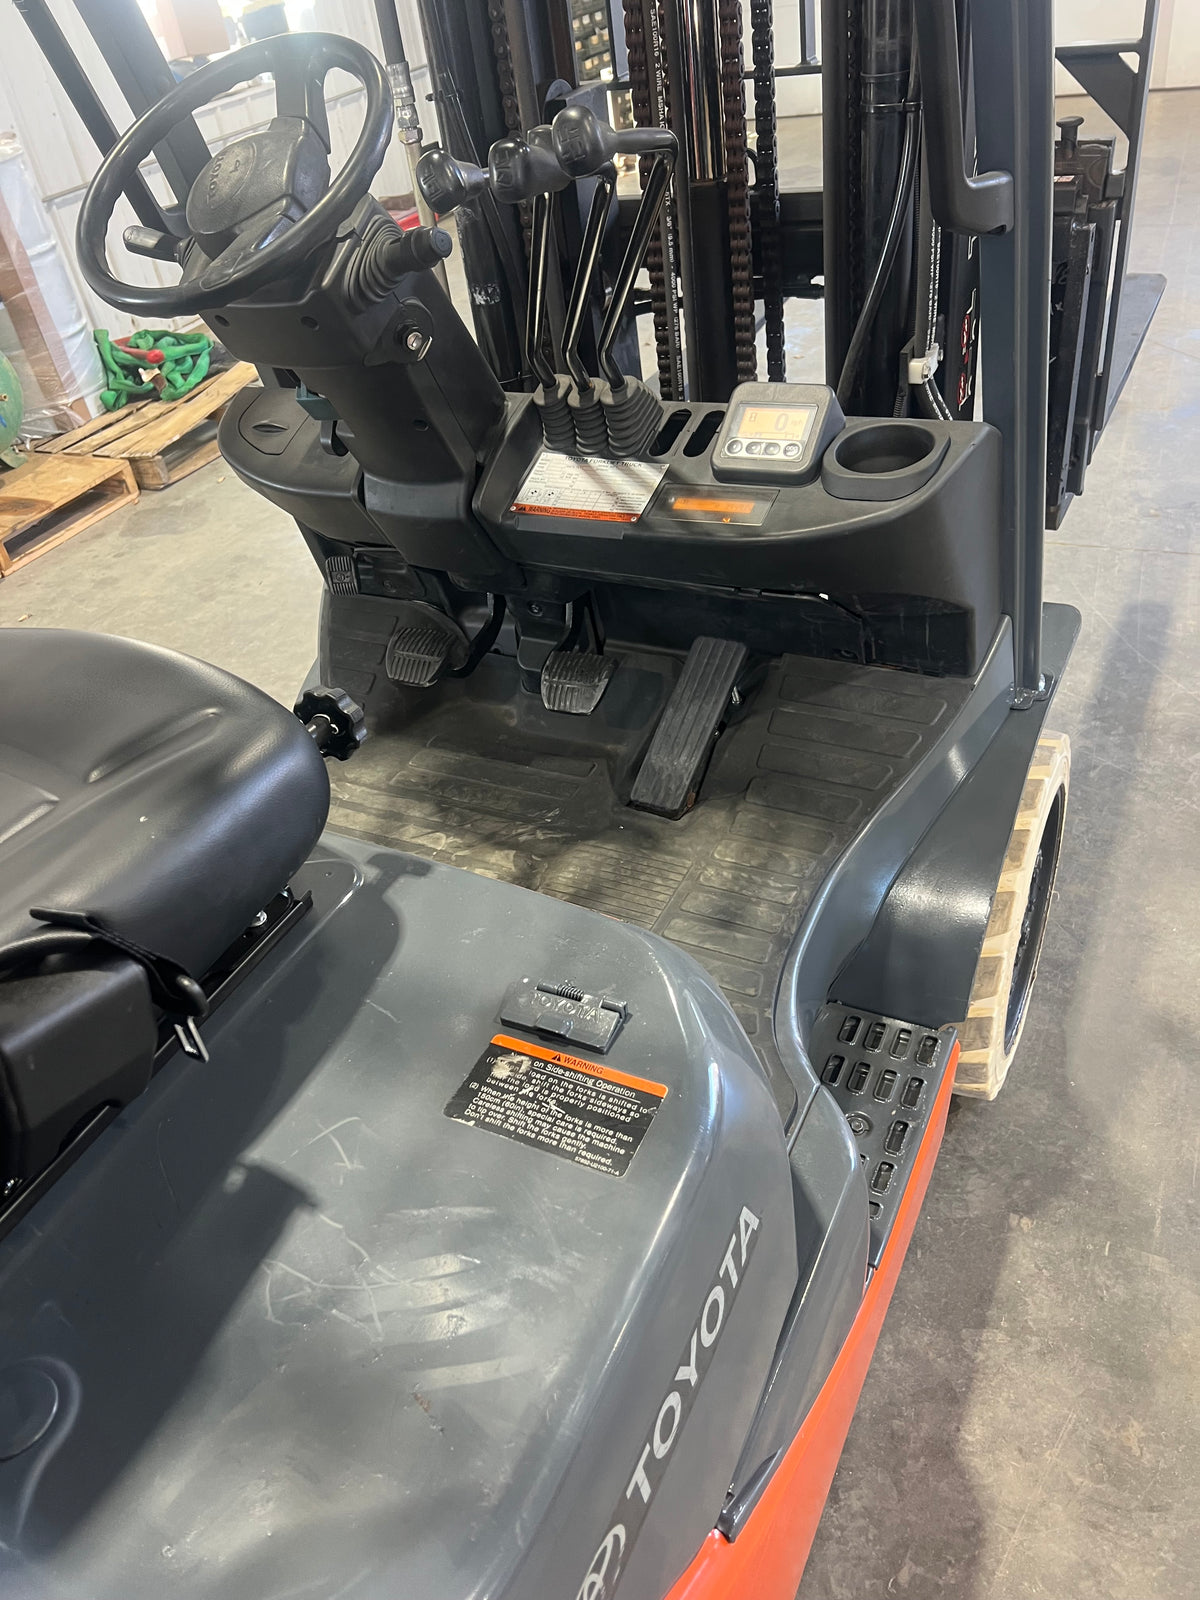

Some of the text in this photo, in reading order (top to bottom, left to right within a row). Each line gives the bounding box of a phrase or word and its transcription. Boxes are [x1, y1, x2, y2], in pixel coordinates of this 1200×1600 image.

[650, 9, 660, 56] SAE100R16
[657, 96, 665, 120] MSHA
[672, 303, 678, 314] WP
[774, 412, 790, 432] 0
[531, 992, 601, 1024] TOYOTA
[486, 1076, 518, 1091] between
[544, 1063, 594, 1084] Side-shifting
[595, 1079, 636, 1098] Operation
[563, 1056, 603, 1073] WARNING
[507, 1076, 519, 1084] the
[522, 1081, 539, 1090] load
[550, 1091, 584, 1107] properly
[587, 1103, 631, 1122] positioned
[528, 1069, 546, 1079] load
[560, 1080, 573, 1088] the
[576, 1085, 596, 1095] forks
[608, 1095, 637, 1109] shifted
[531, 1077, 548, 1087] shift
[551, 1084, 564, 1092] the
[566, 1089, 587, 1099] forks
[589, 1097, 627, 1113] sideways
[472, 1097, 625, 1154] Careless shifting may cause the machine
[477, 1091, 500, 1103] 150cm
[527, 1109, 554, 1122] special
[556, 1119, 572, 1128] care
[583, 1128, 618, 1144] required.
[477, 1105, 487, 1113] tip
[488, 1110, 505, 1119] over.
[507, 1116, 525, 1126] Shift
[527, 1122, 539, 1131] the
[541, 1128, 560, 1138] forks
[561, 1135, 587, 1148] gently.
[480, 1085, 501, 1096] When
[515, 1097, 539, 1110] height
[550, 1109, 562, 1117] the
[564, 1114, 583, 1124] forks
[593, 1124, 613, 1134] more
[615, 1131, 633, 1141] than
[464, 1108, 613, 1165] Don't shift the forks more than required.
[626, 1205, 761, 1505] TOYOTA
